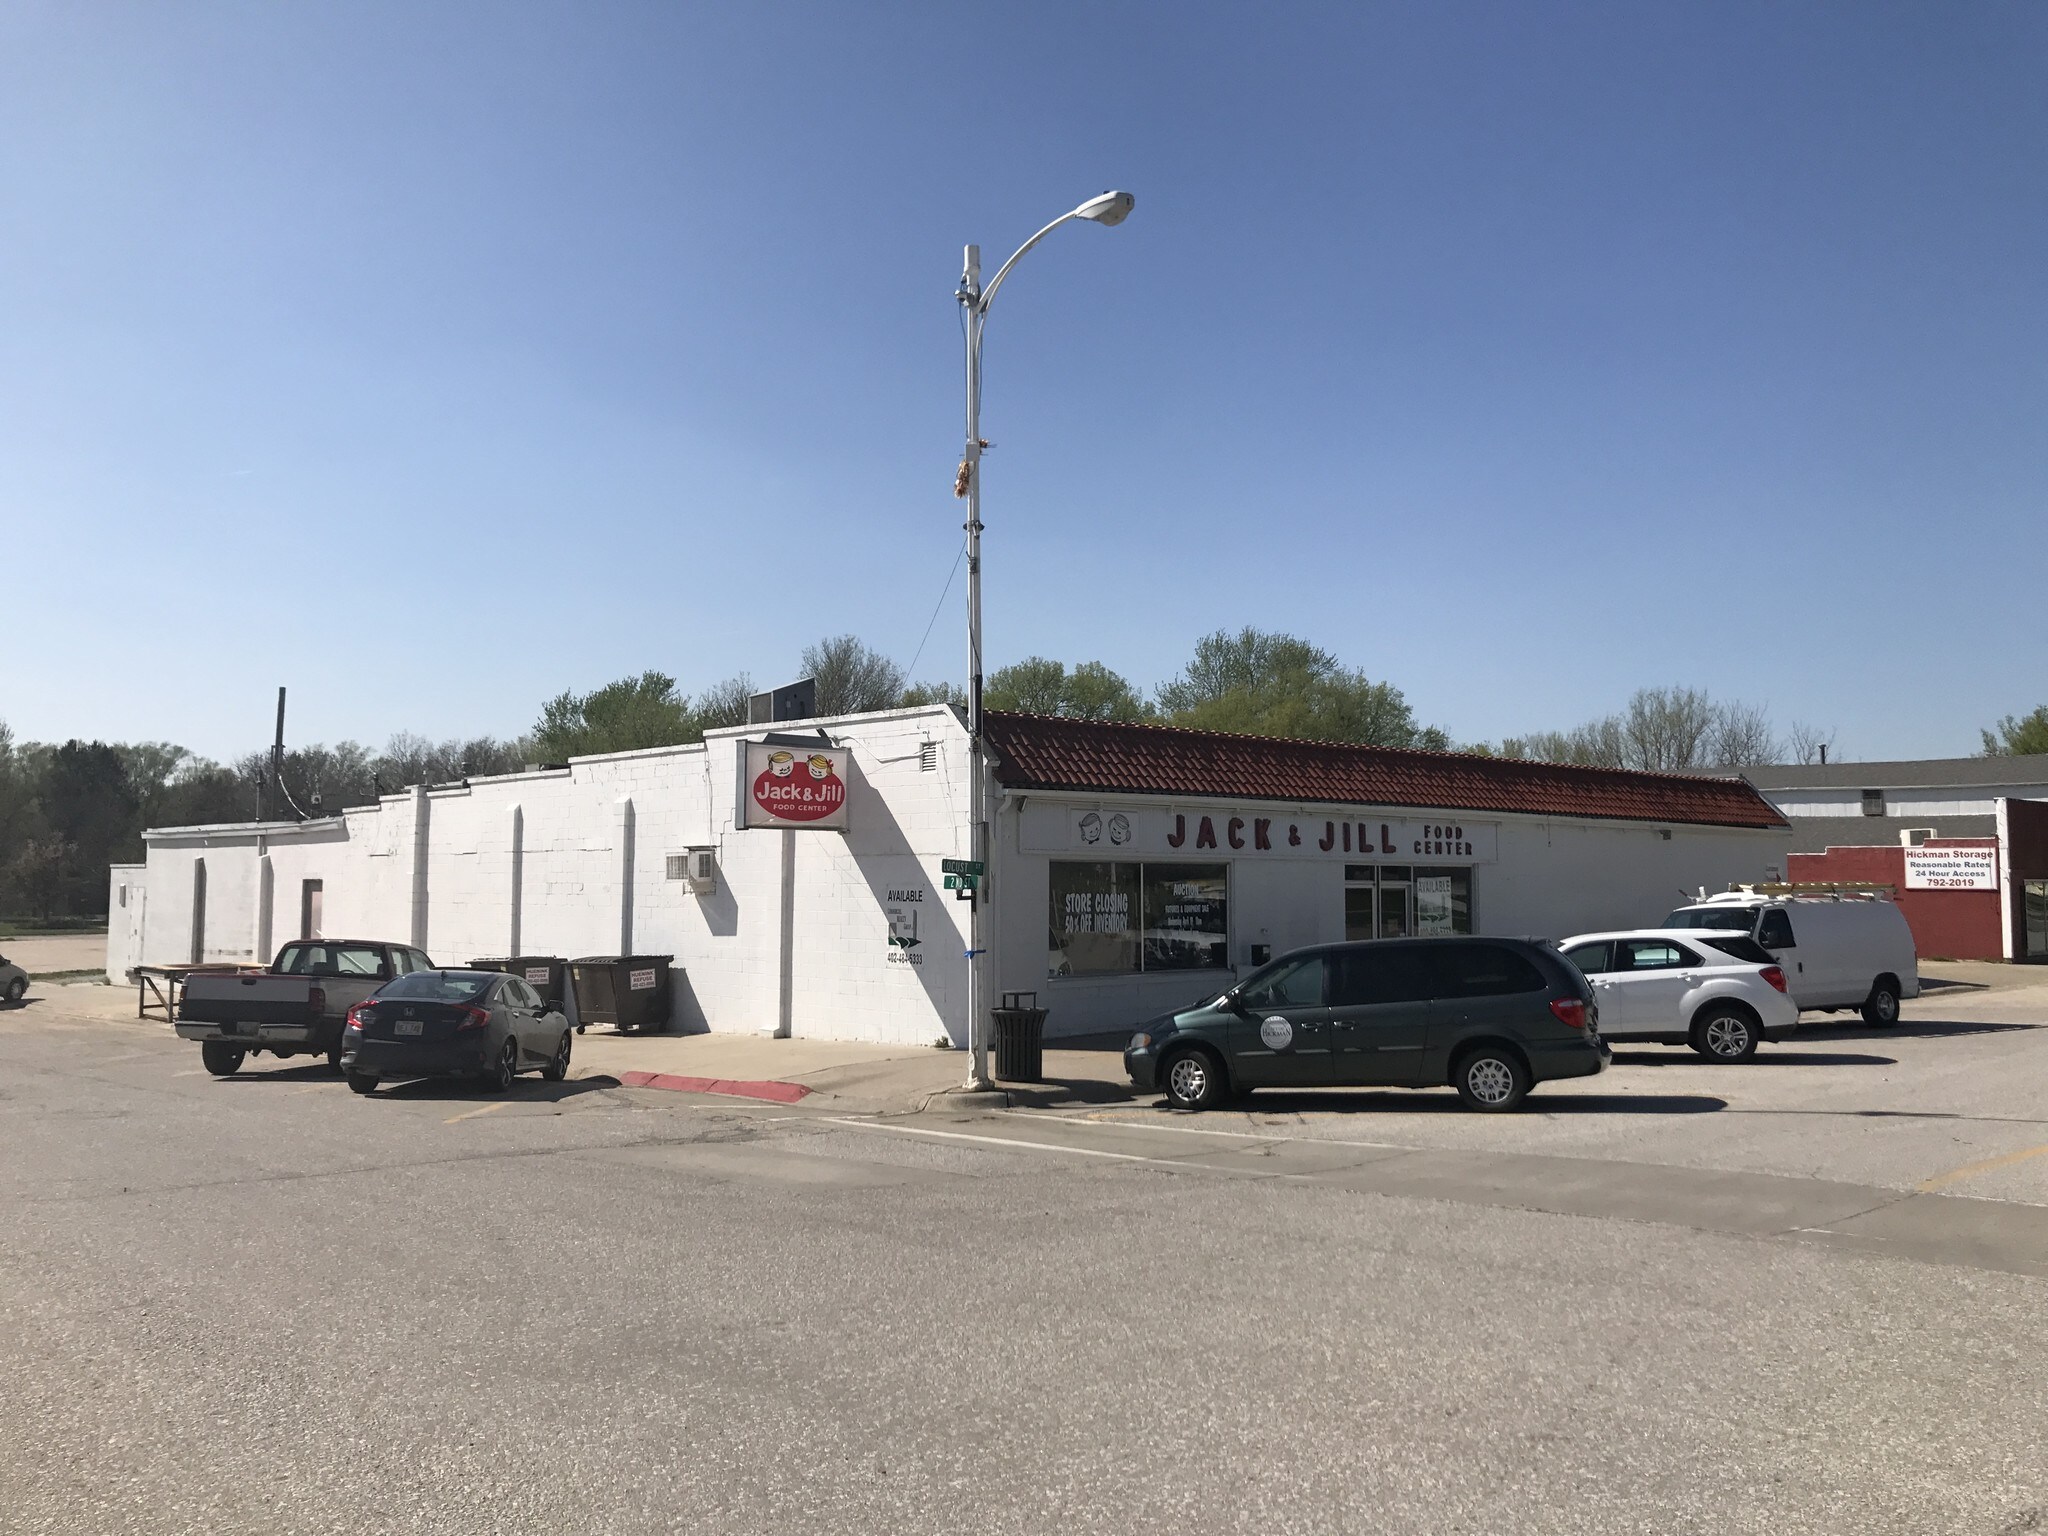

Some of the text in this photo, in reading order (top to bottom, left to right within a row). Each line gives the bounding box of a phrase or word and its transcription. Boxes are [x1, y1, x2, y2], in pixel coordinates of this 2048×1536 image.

[756, 781, 842, 802] Jack & Jill
[773, 803, 827, 812] FOOD CENTER
[1167, 814, 1397, 854] JACK & JILL
[1413, 825, 1473, 856] FOOD CENTER
[1906, 850, 1994, 860] Hickman Storage
[943, 861, 968, 873] LOCUST
[1418, 880, 1451, 893] AVAILABLE
[1926, 878, 1975, 887] 792-2019
[887, 890, 923, 902] AVAILABLE
[1173, 883, 1200, 897] AUCTION
[1065, 893, 1128, 913] STORE CLOSING
[1080, 914, 1092, 933] OFF
[1094, 913, 1128, 933] INVENTORY
